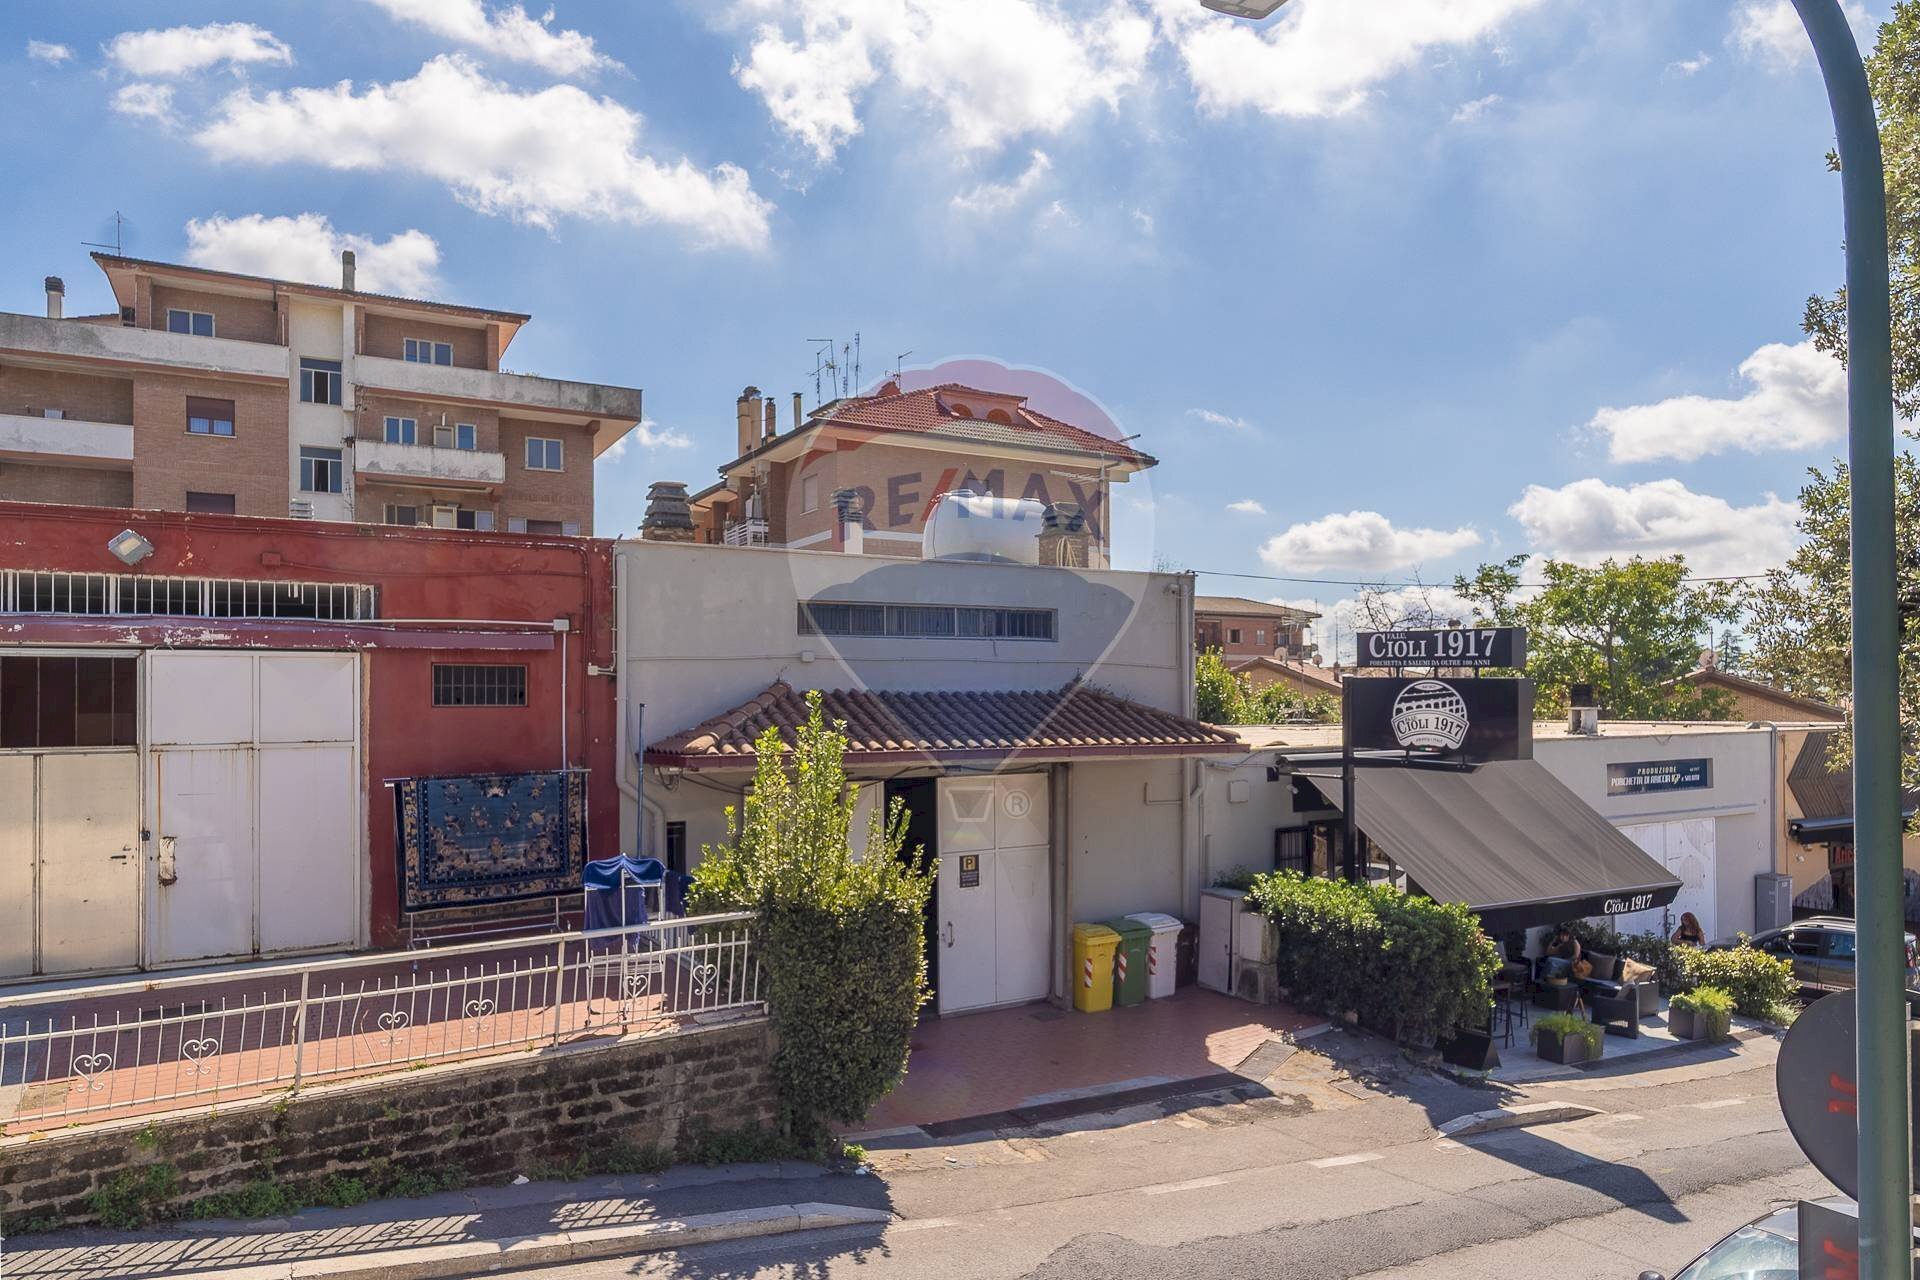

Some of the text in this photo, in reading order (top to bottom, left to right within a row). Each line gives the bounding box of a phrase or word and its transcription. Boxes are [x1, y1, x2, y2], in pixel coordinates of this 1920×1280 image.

[1434, 630, 1497, 657] 1917
[1434, 717, 1463, 738] 1917
[1637, 766, 1677, 775] PRODUZIONE
[1630, 893, 1653, 911] 1917
